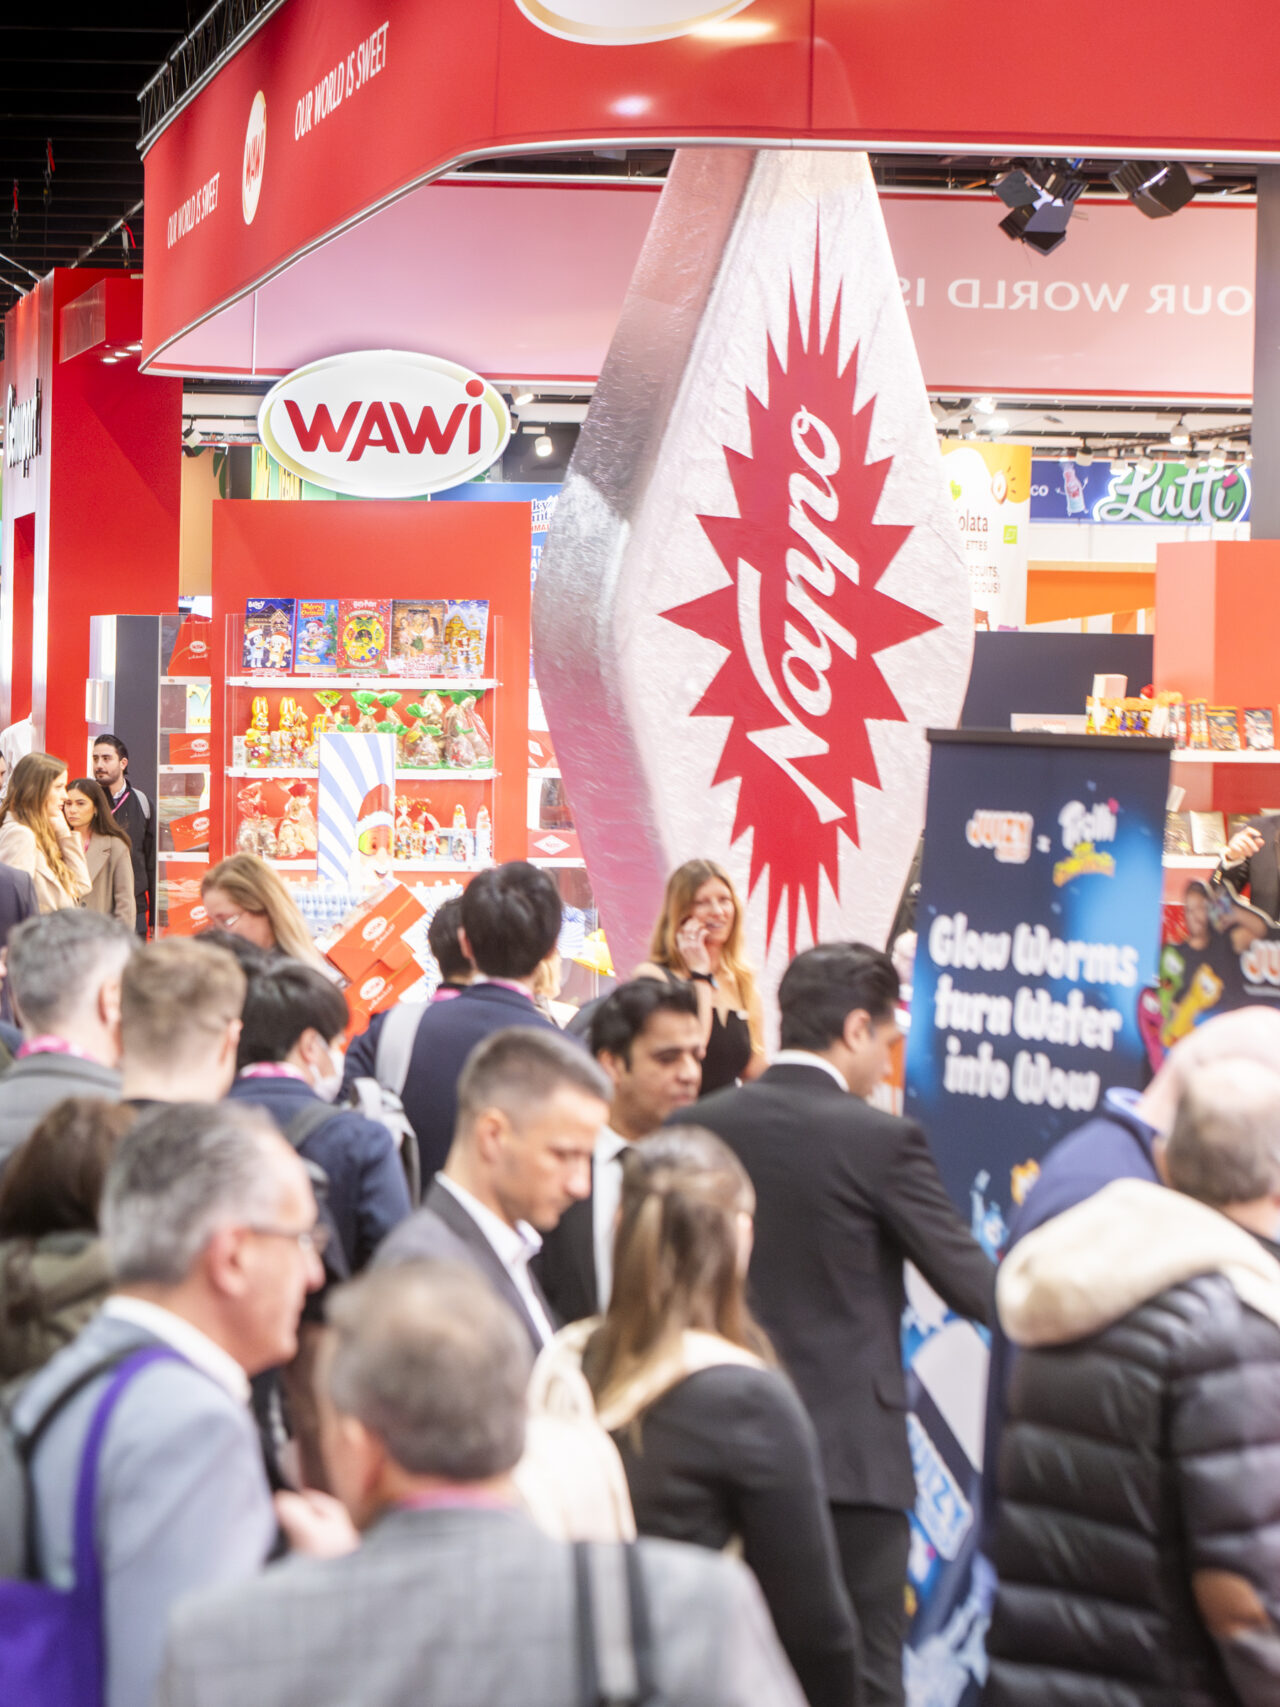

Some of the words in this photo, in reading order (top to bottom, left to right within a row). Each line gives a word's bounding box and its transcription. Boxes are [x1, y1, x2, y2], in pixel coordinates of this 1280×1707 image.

[294, 90, 313, 141] OUR
[314, 61, 345, 126] WORLD
[346, 50, 356, 99] IS
[356, 20, 390, 90] SWEET
[167, 211, 179, 249] OUR
[178, 195, 196, 240] WORLD
[201, 171, 220, 221] SWEET
[1098, 462, 1239, 522] Lutti
[928, 912, 1012, 971] Glow
[1012, 922, 1139, 988] Worms
[933, 973, 1012, 1037] turn
[1013, 986, 1123, 1052] Water
[943, 1035, 1011, 1101] into
[1012, 1050, 1101, 1113] Wow
